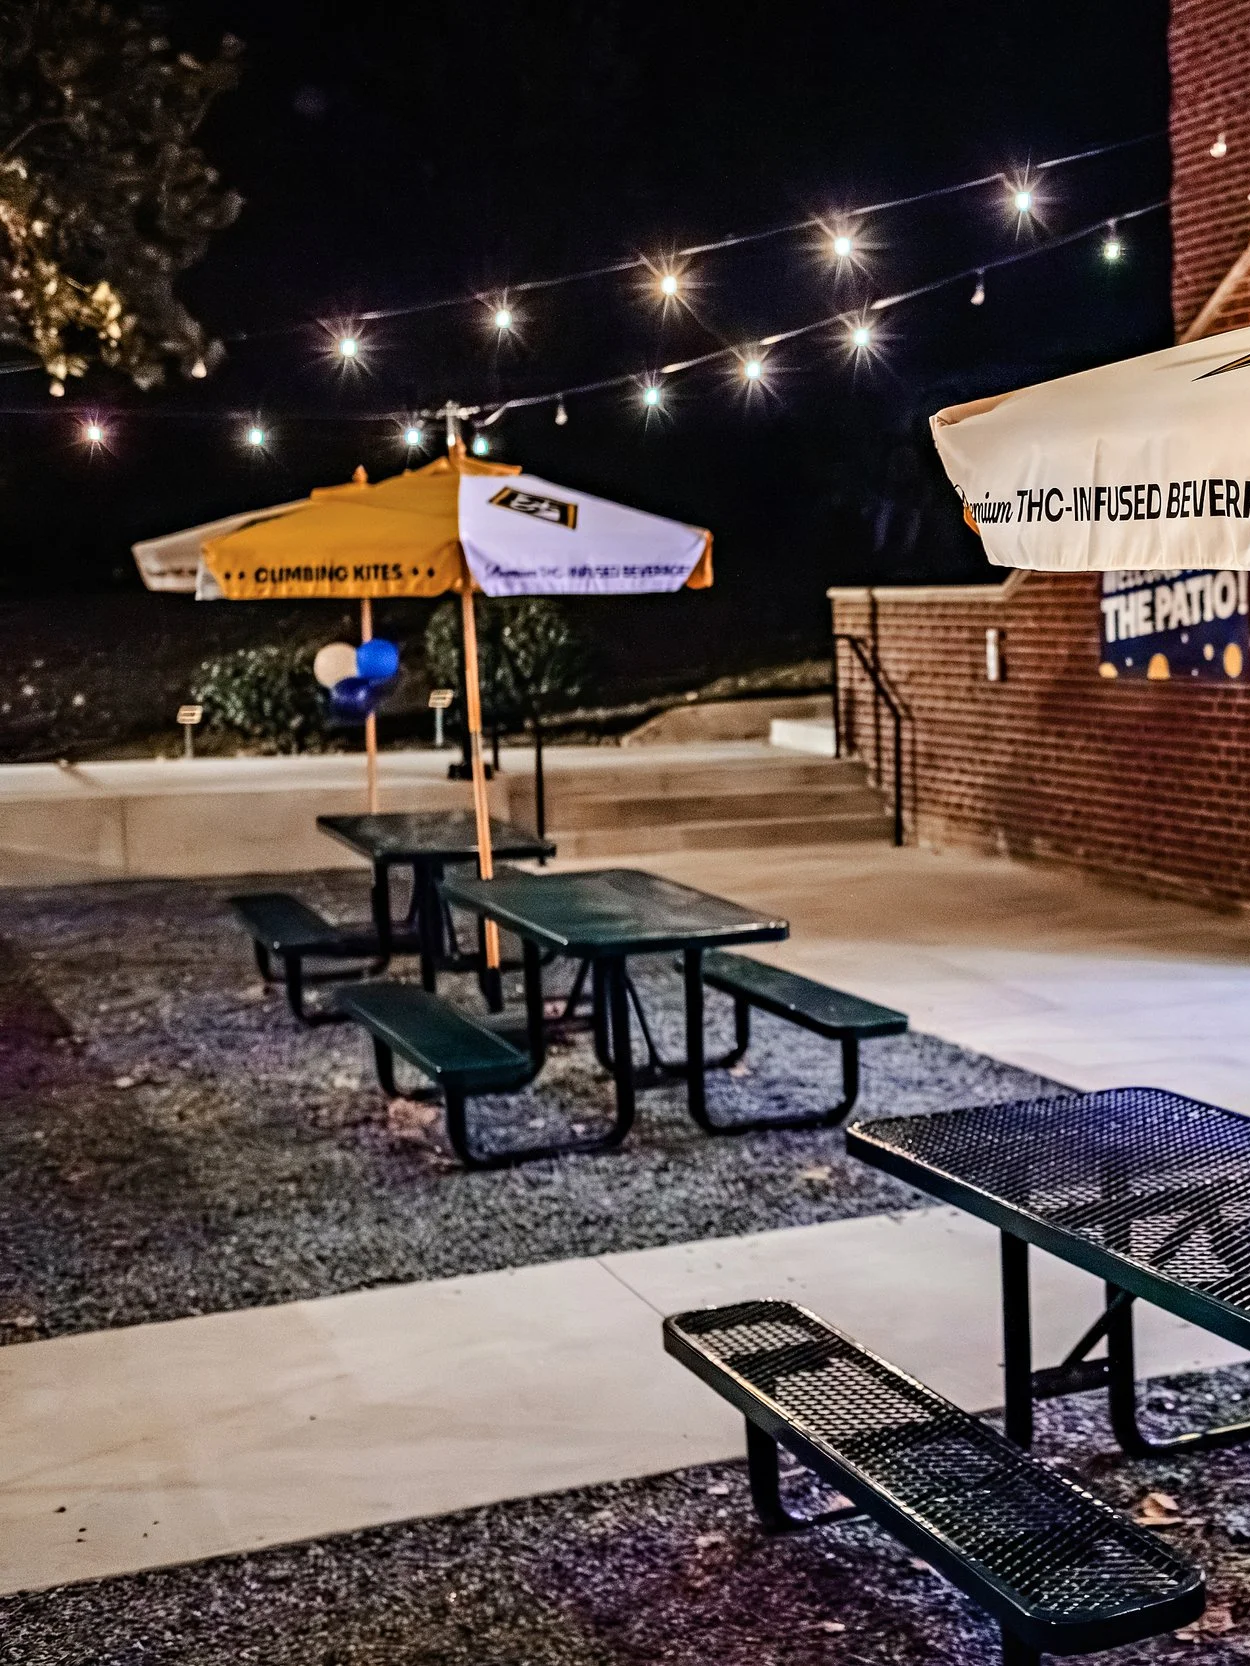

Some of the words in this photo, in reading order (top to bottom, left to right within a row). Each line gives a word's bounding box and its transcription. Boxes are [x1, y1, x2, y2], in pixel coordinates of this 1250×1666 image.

[954, 484, 1014, 524] mium
[1016, 482, 1162, 523] THC-INFUSED
[254, 566, 349, 584] CLIMBING
[353, 563, 403, 581] KITES
[1101, 590, 1154, 643] THE
[1154, 571, 1249, 633] PATIO!
